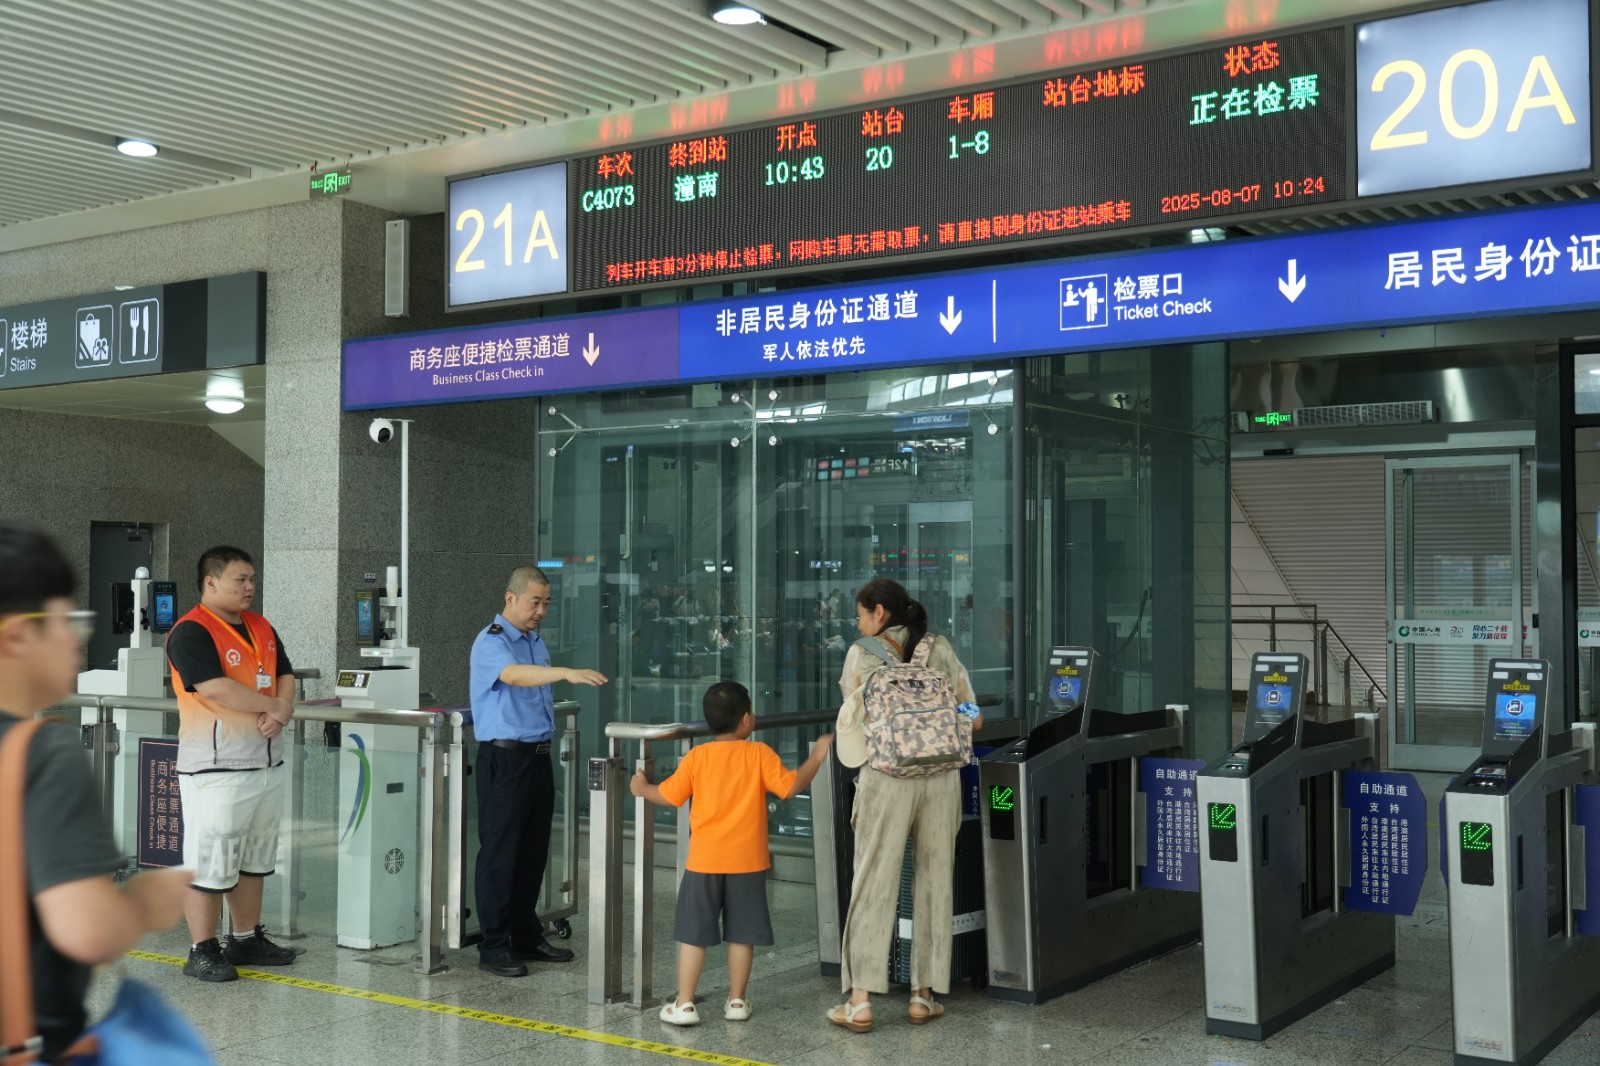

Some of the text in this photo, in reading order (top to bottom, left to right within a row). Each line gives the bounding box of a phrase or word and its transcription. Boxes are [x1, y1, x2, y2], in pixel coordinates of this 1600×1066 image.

[1223, 41, 1280, 77] 状态
[1043, 65, 1146, 108] 站台地标
[1189, 74, 1320, 125] 正在检票
[1370, 48, 1576, 151] 20A
[861, 106, 905, 137] 站台
[948, 91, 996, 124] 车厢
[669, 135, 728, 168] 终到站
[776, 121, 817, 152] 开点
[949, 130, 990, 160] 1-8
[597, 151, 634, 180] 车次
[765, 155, 825, 186] 10:43
[866, 145, 893, 171] 20
[582, 184, 635, 212] C4073
[674, 171, 719, 203] 潼南
[1161, 176, 1325, 214] 2025-08-07 10:24
[455, 202, 559, 274] 21A
[1384, 234, 1600, 290] 居民身份证
[1113, 273, 1183, 299] 检票口
[715, 290, 919, 337] 非居民身份证通道
[1114, 298, 1212, 322] Ticket Check
[11, 317, 48, 351] 楼梯
[762, 336, 866, 362] 军人依法优先
[10, 356, 37, 373] Stairs
[409, 332, 571, 371] 商务座便捷检票通道
[432, 366, 545, 386] Business Class Check in
[1360, 782, 1408, 797] 自助通道
[156, 760, 168, 851] 商务座便捷
[1369, 802, 1400, 814] 支持
